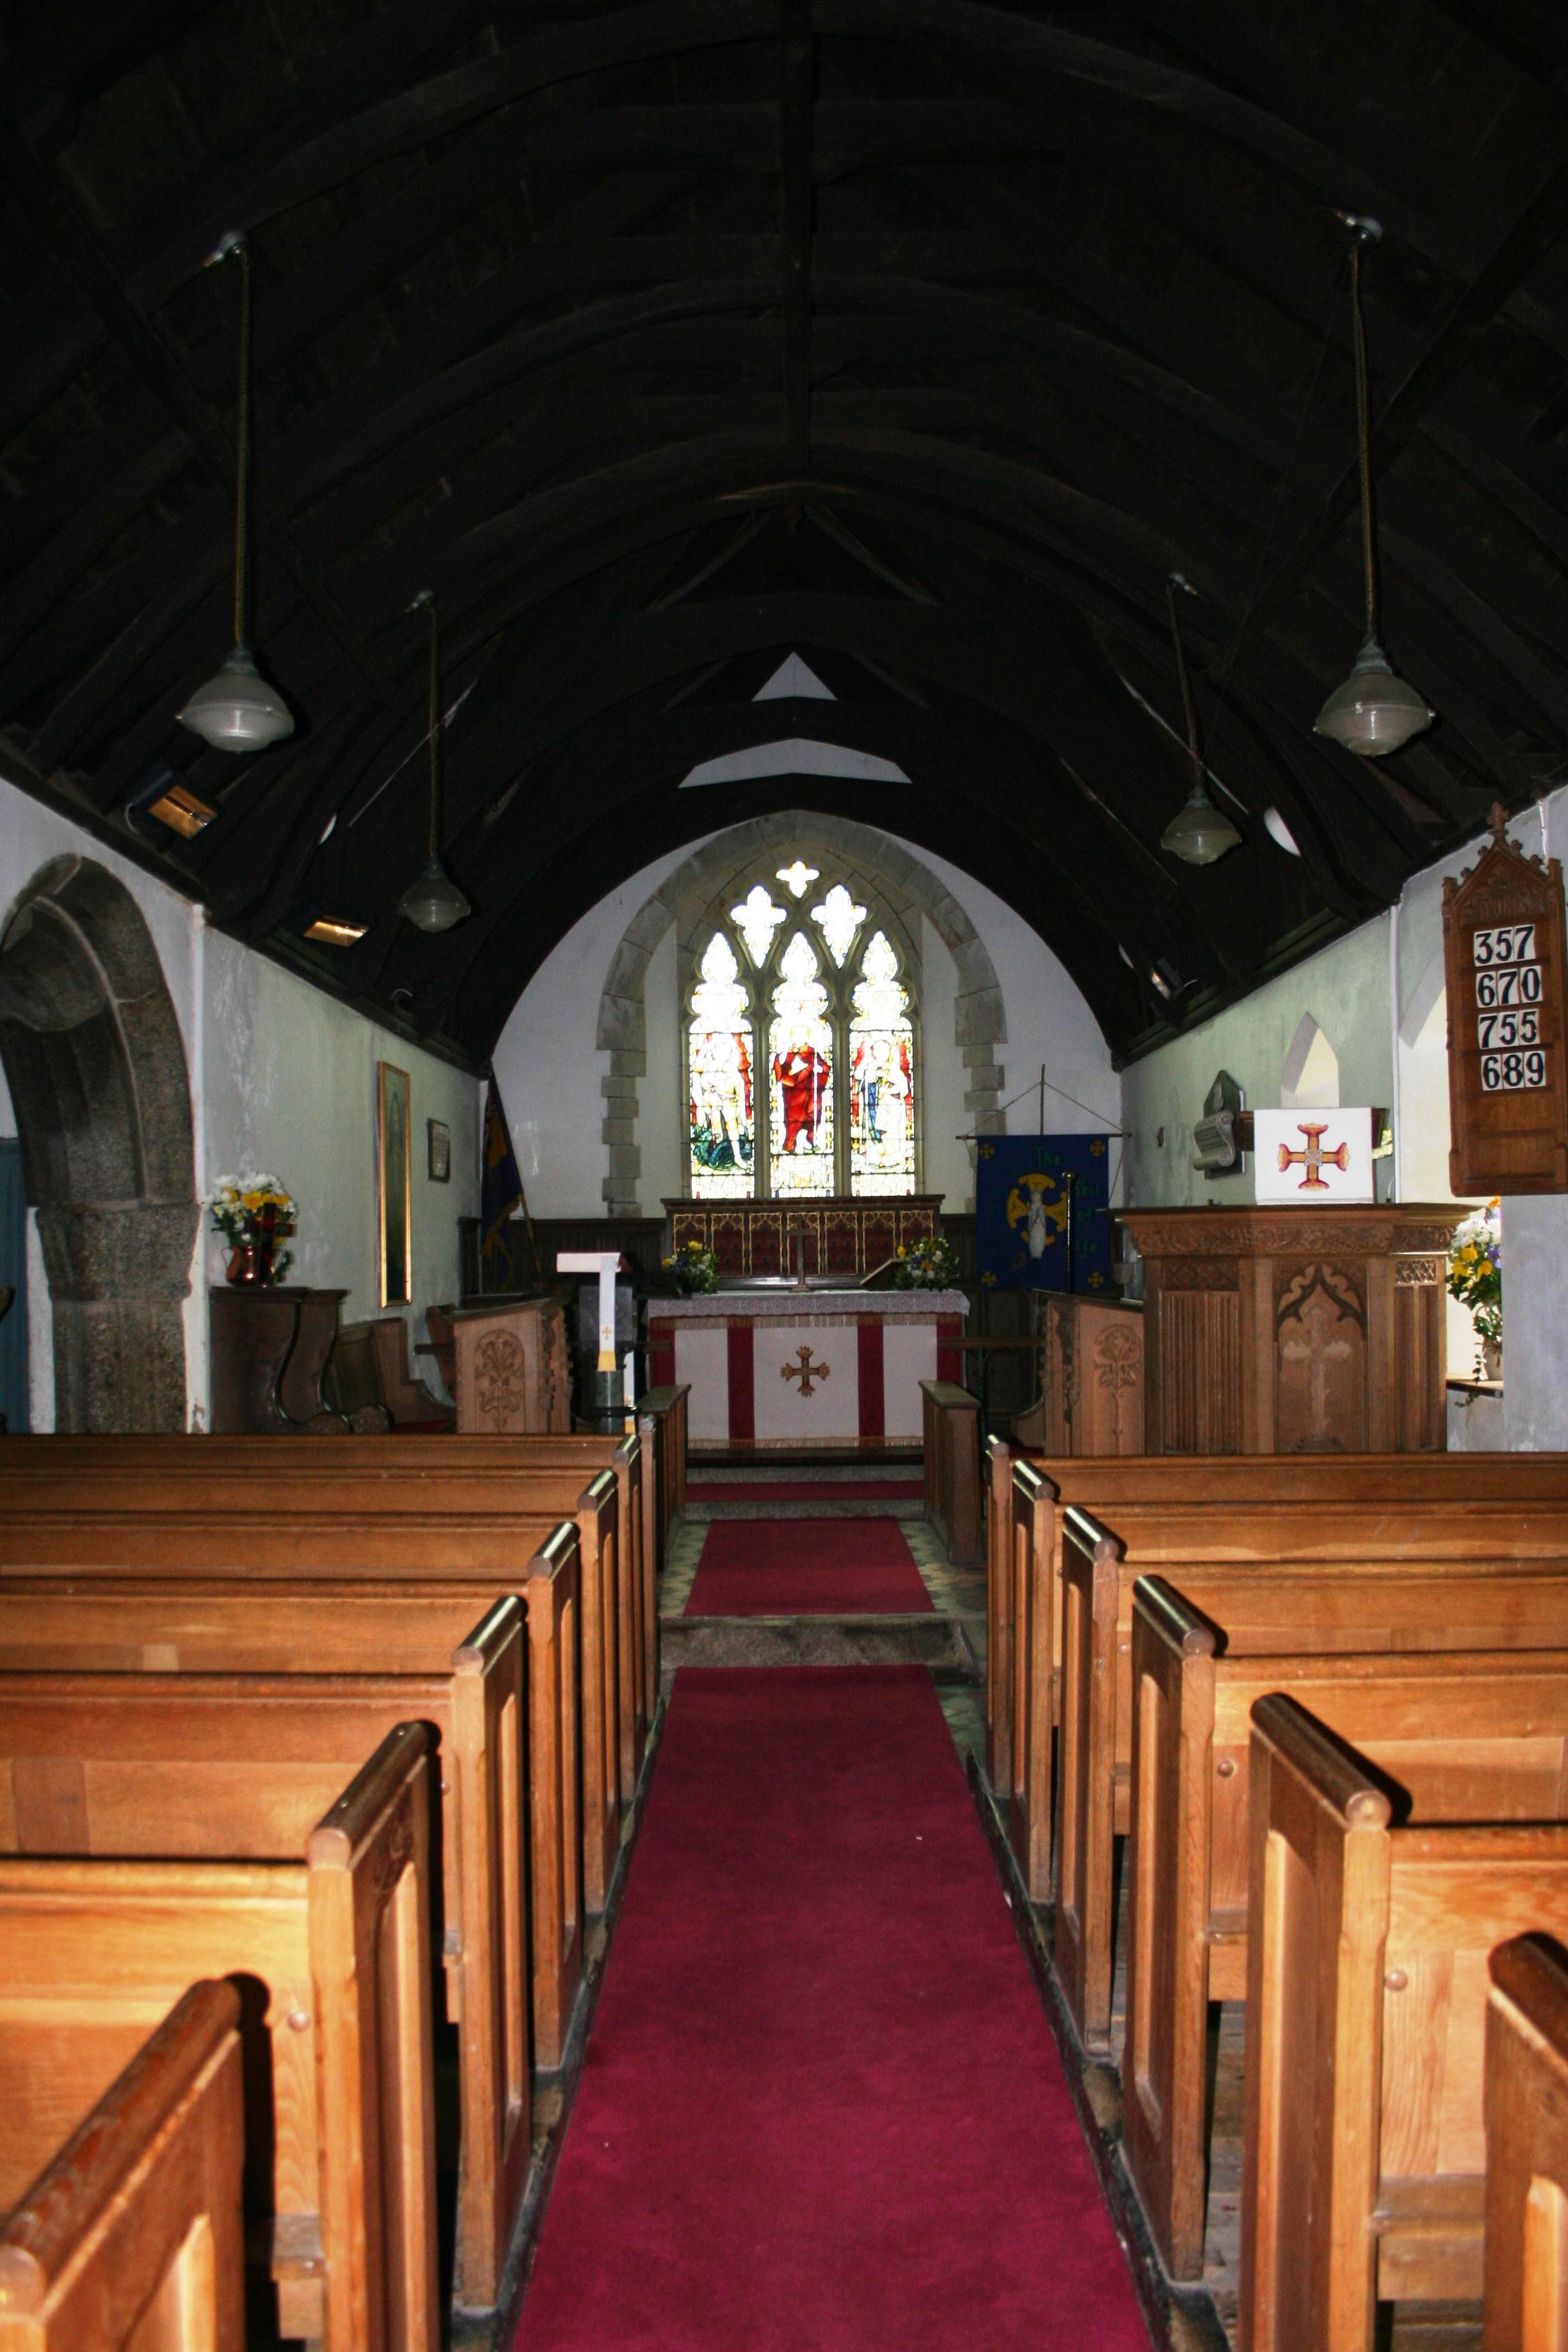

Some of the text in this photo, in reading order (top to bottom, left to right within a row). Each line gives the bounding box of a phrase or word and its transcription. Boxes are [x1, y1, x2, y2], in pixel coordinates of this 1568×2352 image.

[1475, 925, 1535, 965] 357
[1477, 968, 1540, 1007] 670
[1480, 1011, 1537, 1049] 755
[1482, 1052, 1544, 1090] 689
[1035, 1145, 1062, 1169] The
